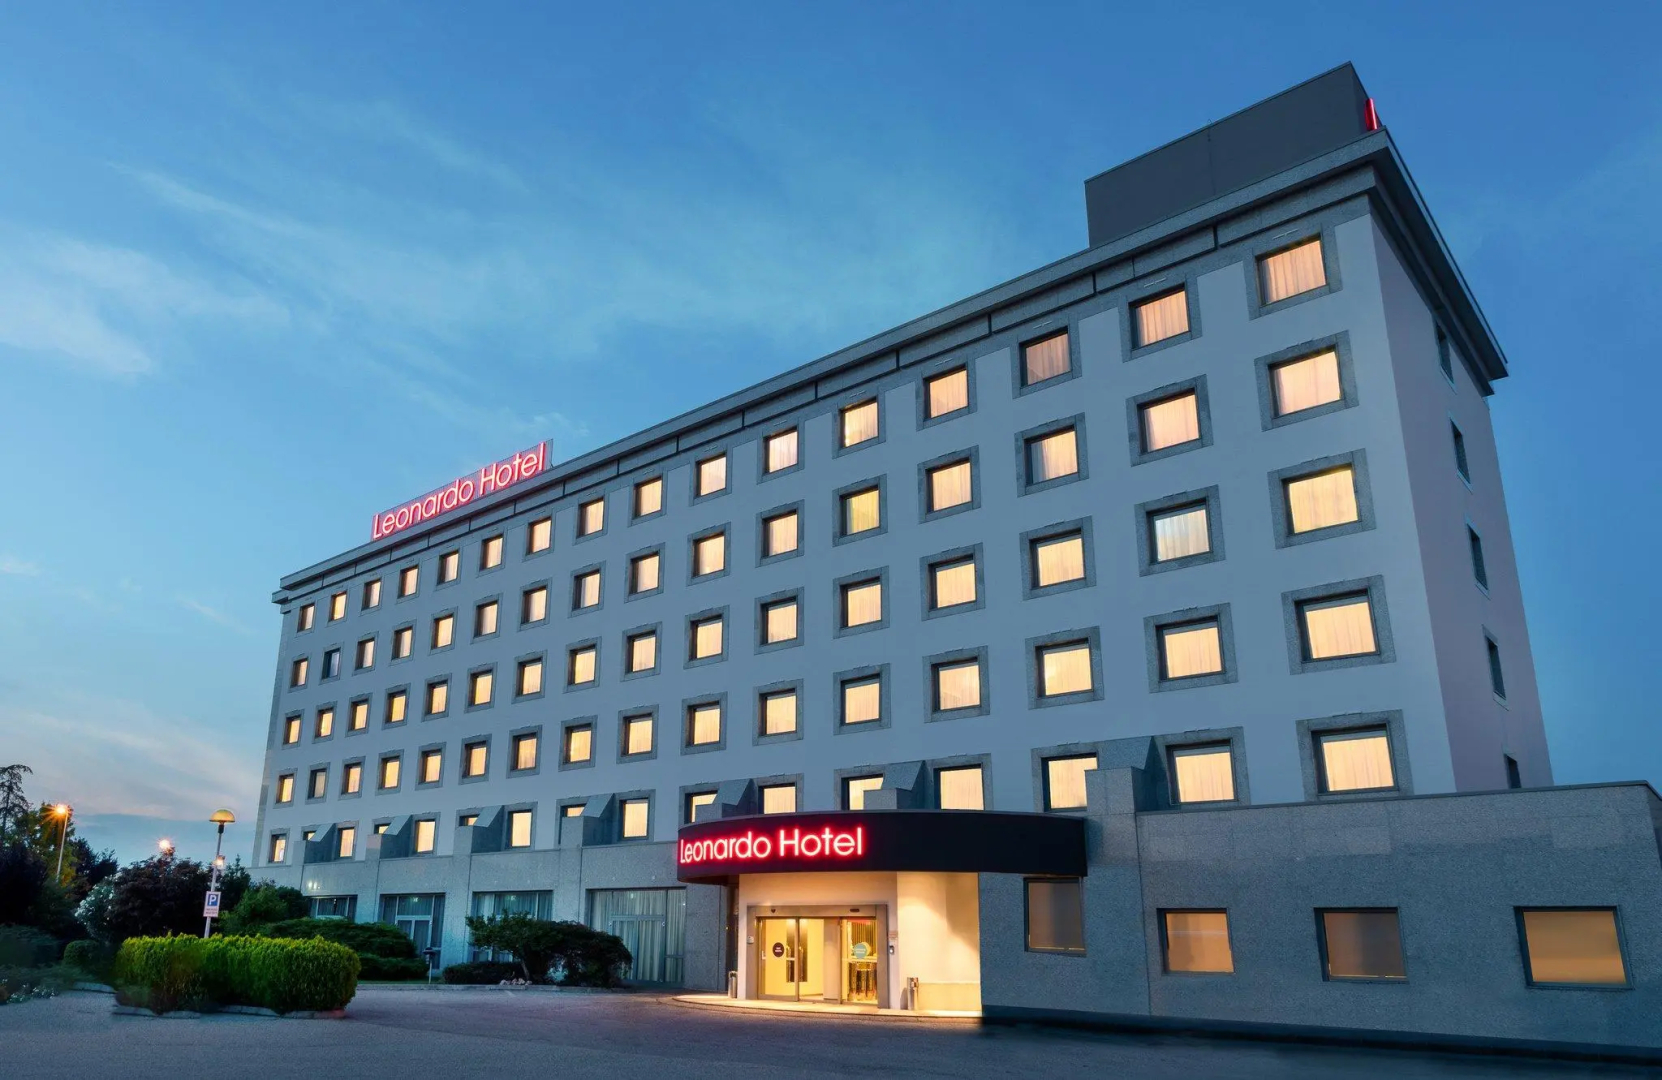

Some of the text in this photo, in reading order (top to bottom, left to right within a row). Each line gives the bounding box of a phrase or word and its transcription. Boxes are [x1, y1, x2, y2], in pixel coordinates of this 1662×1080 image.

[373, 441, 547, 539] Leonardo Hotel
[680, 826, 863, 863] Leonardo Hotel
[209, 894, 217, 905] P
